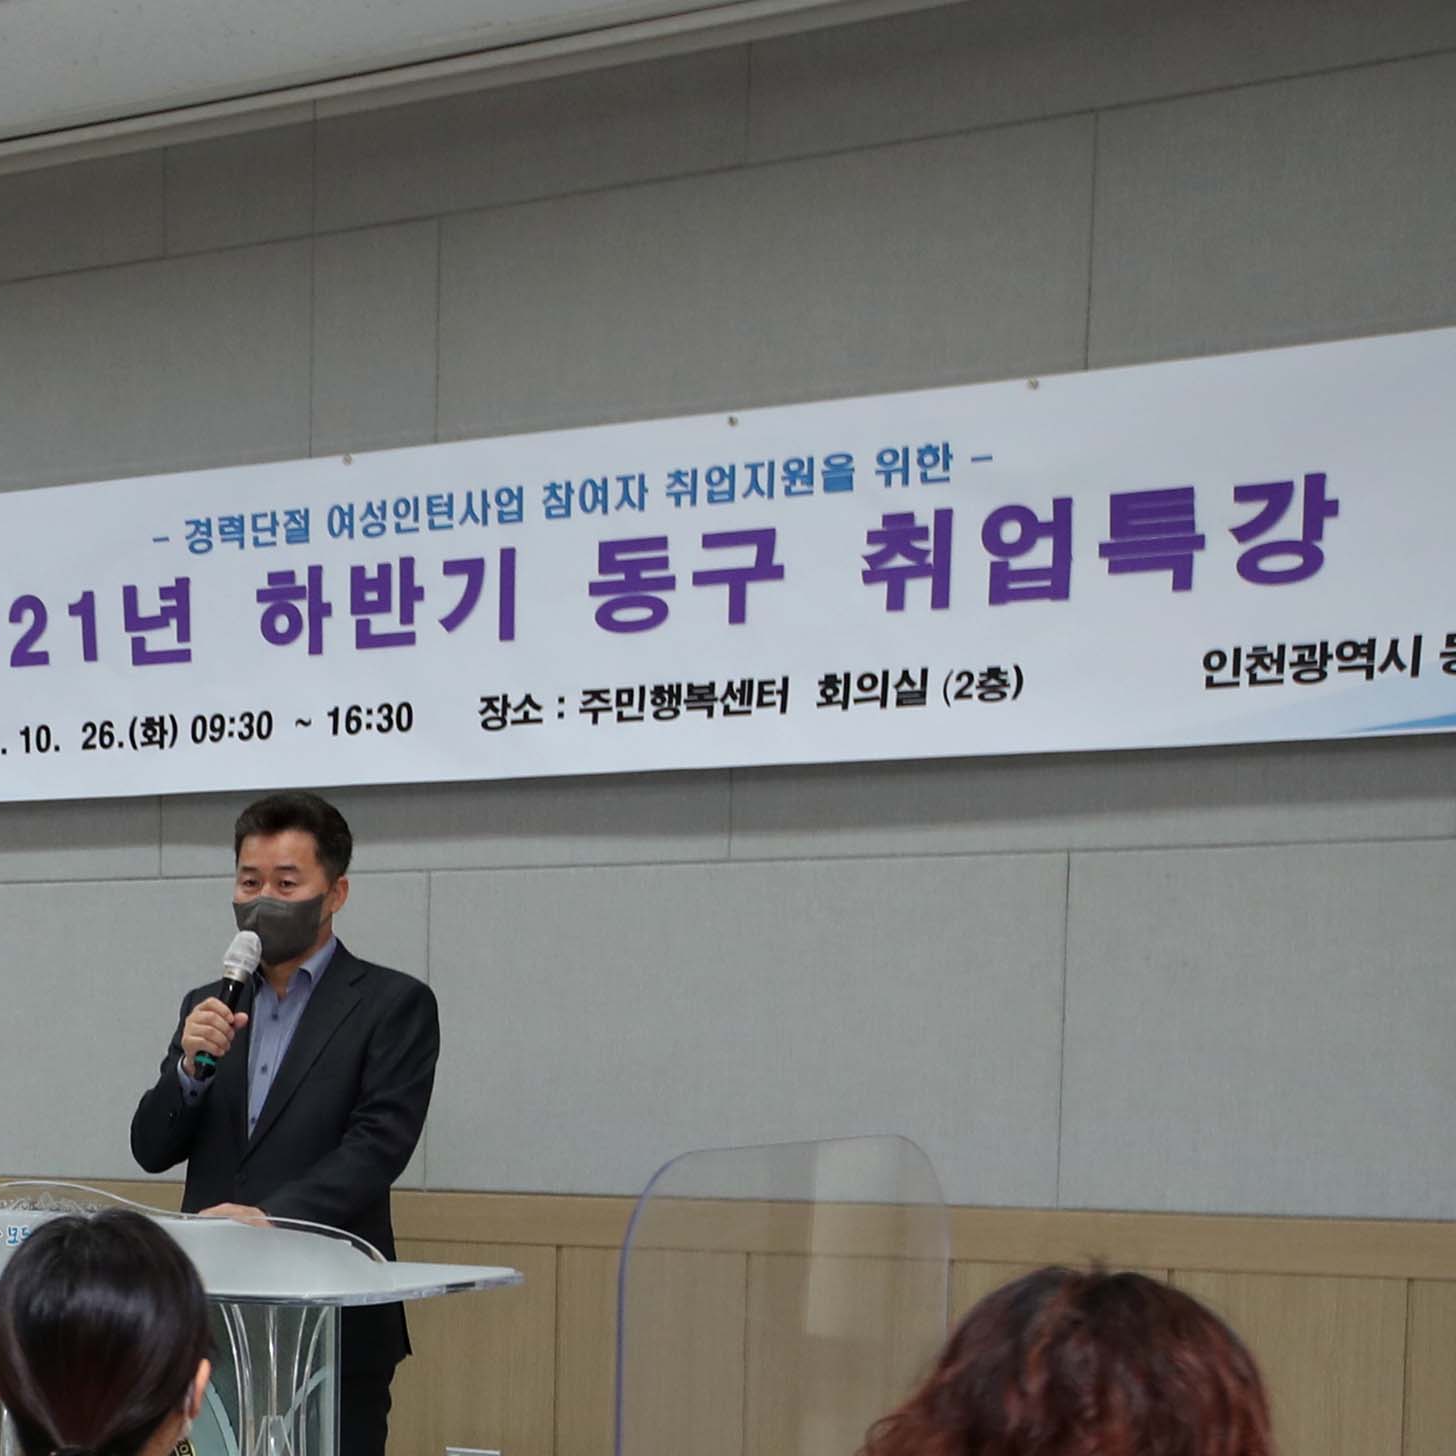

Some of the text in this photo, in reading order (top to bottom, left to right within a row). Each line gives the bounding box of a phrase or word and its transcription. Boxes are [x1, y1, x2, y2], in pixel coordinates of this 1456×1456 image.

[183, 506, 312, 556] 경력단절
[326, 484, 526, 541] 여성인턴사업
[541, 471, 650, 521] 참여자
[664, 450, 856, 509] 취업지원을
[874, 440, 955, 490] 위한
[254, 544, 518, 657] 하반기
[586, 526, 786, 636] 동구
[859, 471, 1342, 613] 취업특강
[1202, 632, 1424, 691] 인천광역시
[18, 723, 61, 755] 10.
[190, 708, 274, 746] 09:30
[326, 700, 414, 738] 16:30
[477, 692, 545, 733] 장소
[578, 674, 790, 727] 주민행복센터
[815, 665, 930, 714] 회의실
[941, 662, 1025, 709] (2층)
